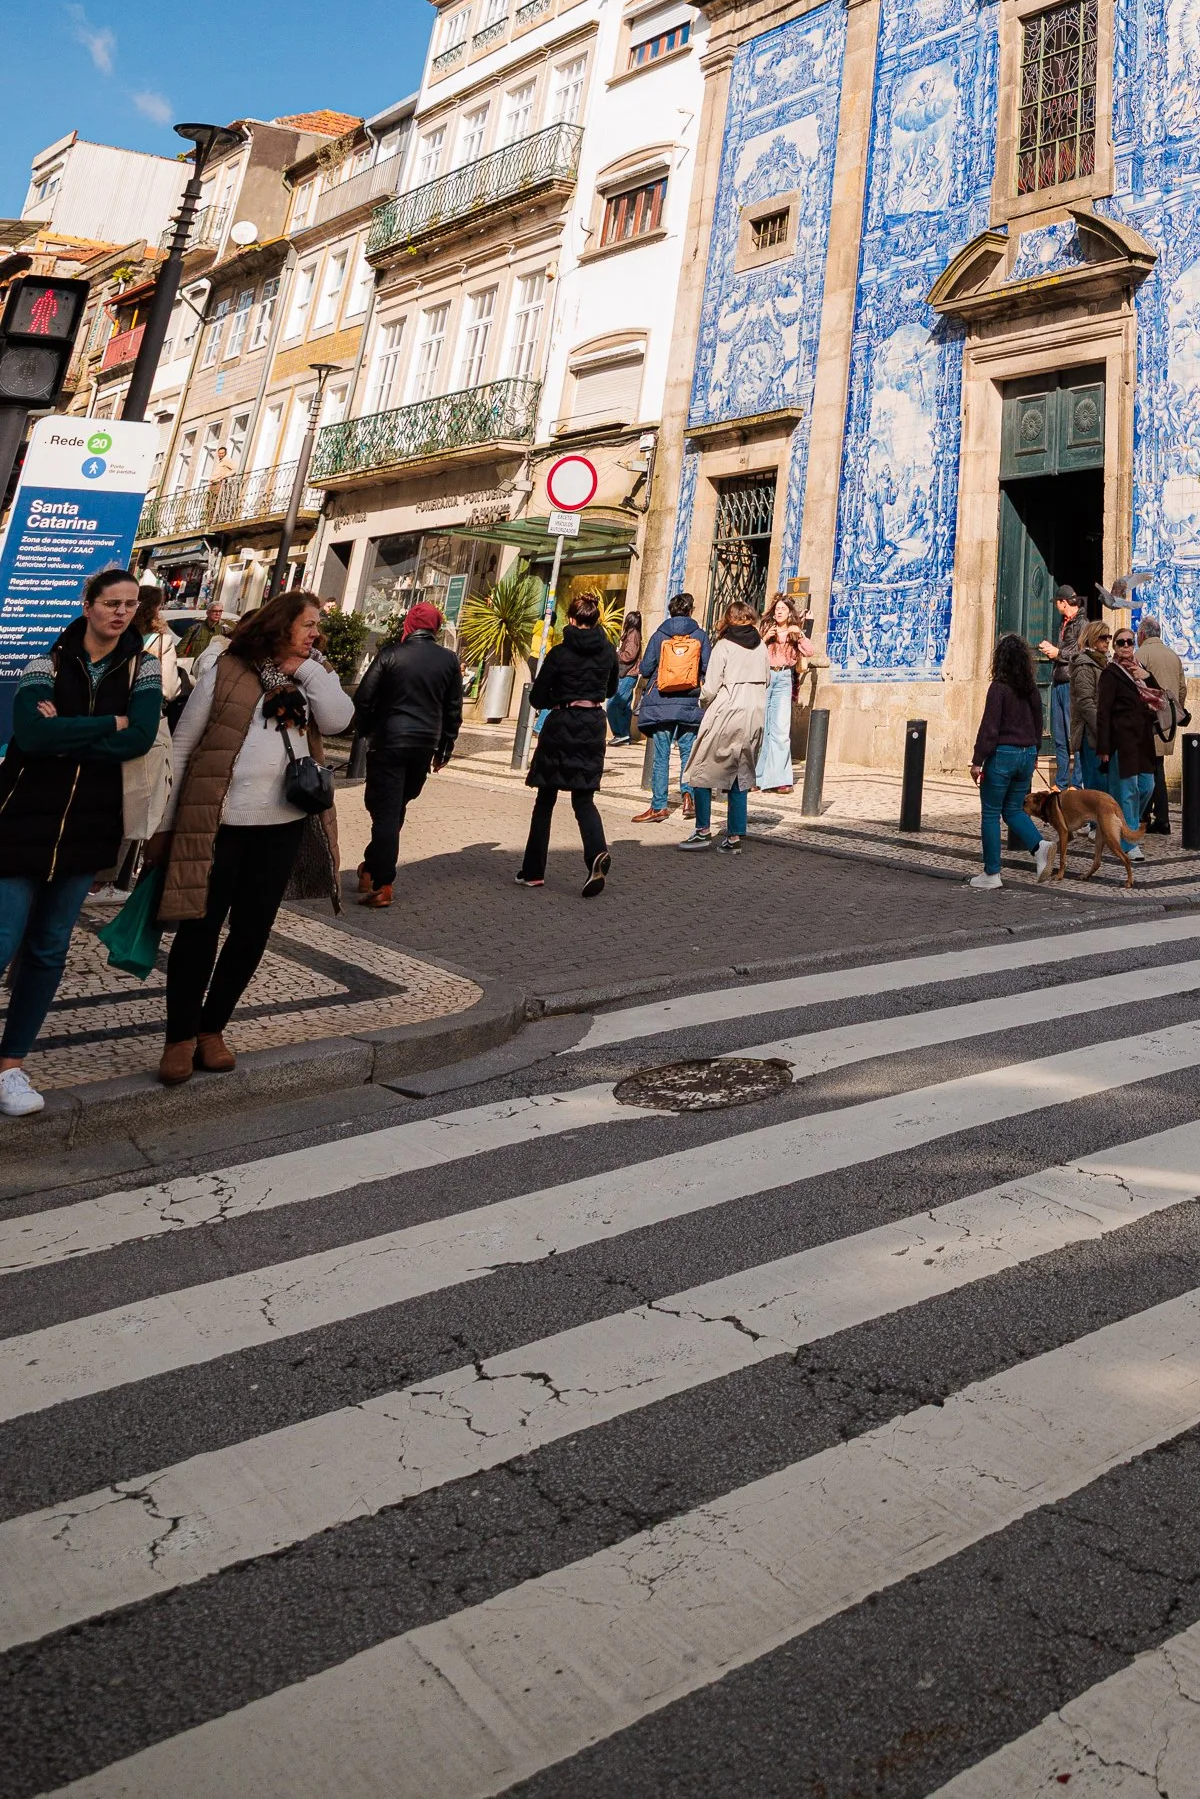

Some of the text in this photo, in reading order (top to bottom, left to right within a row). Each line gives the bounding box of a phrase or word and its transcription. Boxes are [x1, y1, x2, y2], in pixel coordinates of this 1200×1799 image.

[50, 435, 108, 449] Rede 20
[30, 499, 79, 515] Santa
[27, 514, 98, 530] Catarina
[41, 536, 51, 544] de
[78, 538, 115, 546] automóvel
[19, 545, 67, 553] condicionado
[73, 546, 94, 554] ZAAC
[16, 554, 47, 562] Restricted
[10, 578, 78, 587] Registro obrigatório
[46, 598, 71, 606] veículo
[27, 625, 43, 634] pelo
